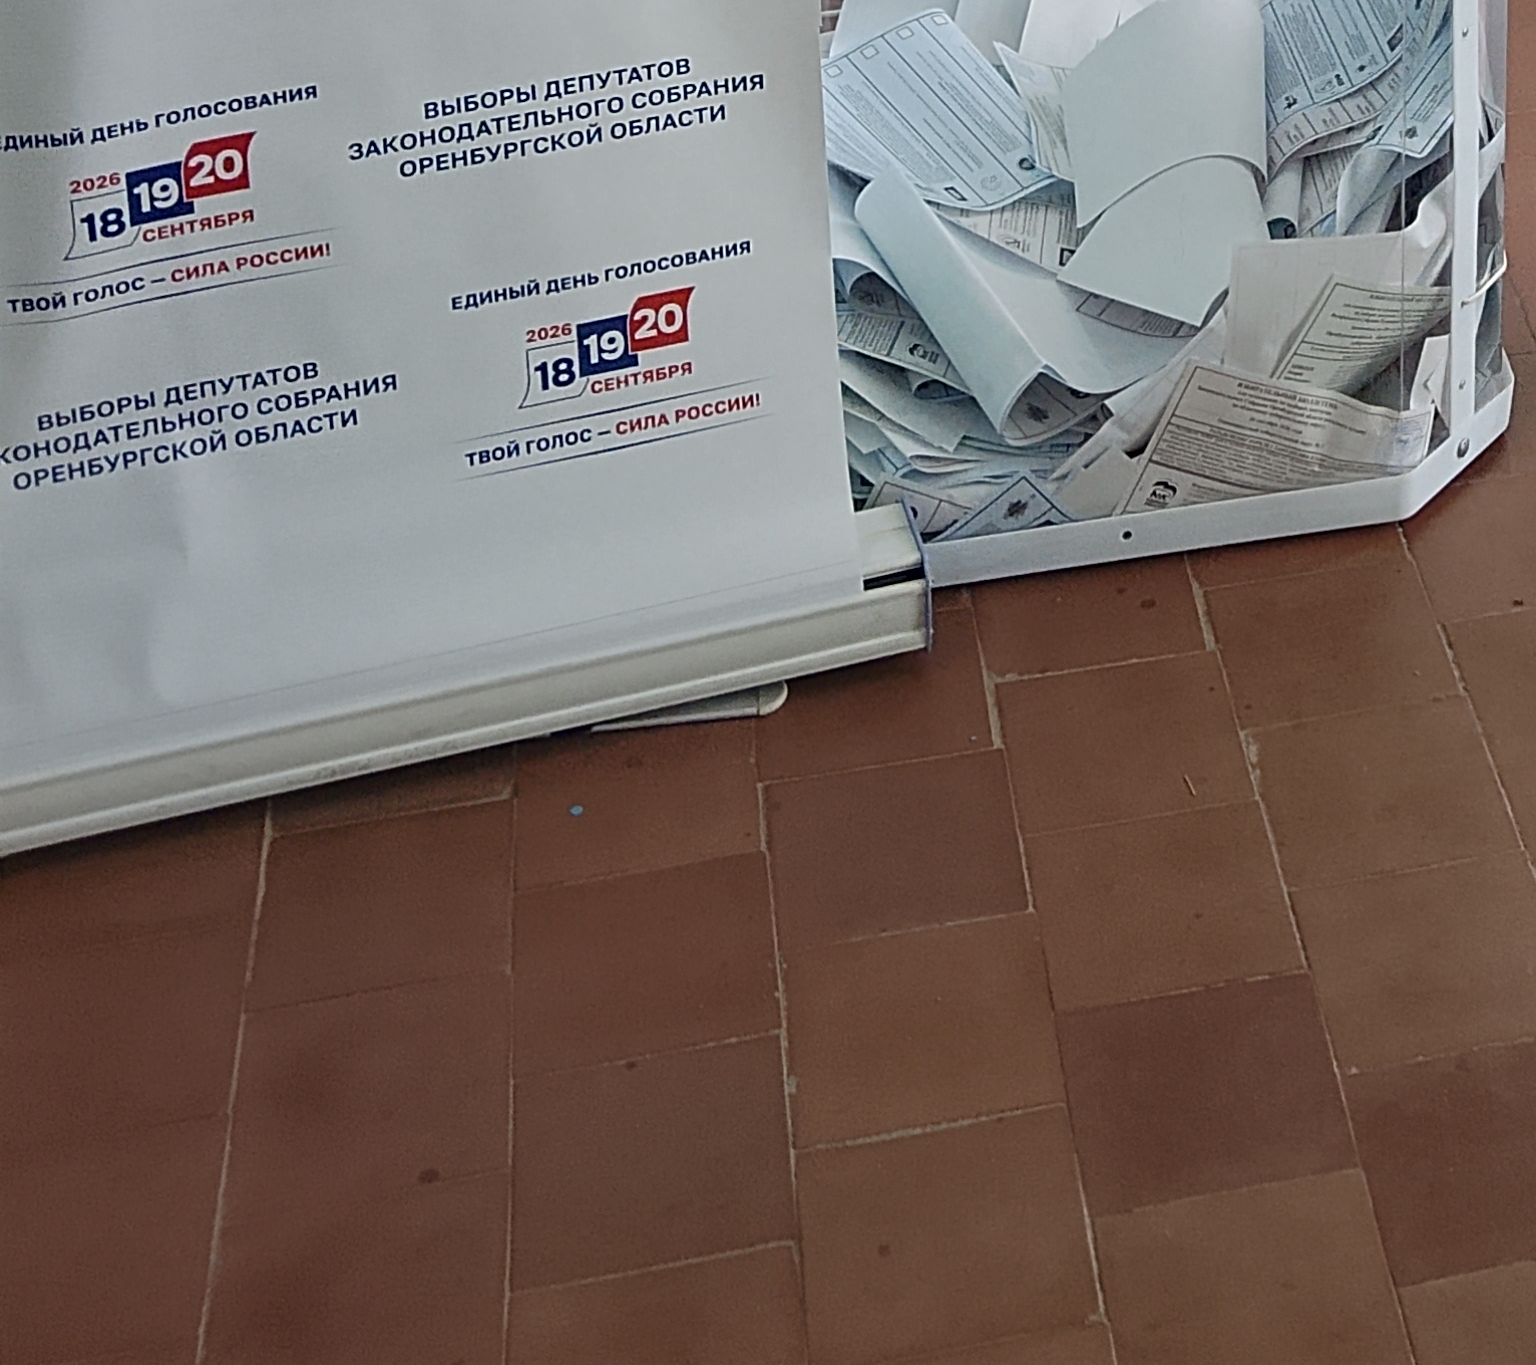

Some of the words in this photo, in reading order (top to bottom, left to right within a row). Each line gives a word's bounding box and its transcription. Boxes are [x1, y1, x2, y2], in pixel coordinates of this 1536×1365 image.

[0, 127, 86, 154] ДИНЫЙ
[90, 118, 149, 145] ДЕНЬ
[154, 85, 318, 128] ГОЛОСОВАНИЯ
[348, 90, 624, 161] ЗАКОНОДАТЕЛЬНОГО
[630, 73, 765, 112] СОБРАНИЯ
[423, 83, 537, 120] ВЫБОРЫ
[544, 58, 691, 101] ДЕПУТАТОВ
[399, 127, 604, 178] ОРЕНБУРГСКОЙ
[610, 104, 726, 140] ОБЛАСТИ
[68, 172, 121, 195] 2026
[79, 207, 127, 243] 18
[134, 177, 179, 213] 19
[188, 148, 243, 187] 20
[142, 209, 255, 243] СЕНТЯБРЯ
[6, 291, 67, 313] ТВОЙ
[72, 276, 146, 307] ГОЛОС
[171, 260, 230, 287] СИЛА
[235, 242, 331, 275] РОССИИ!
[451, 278, 540, 311] ЕДИНЫЙ
[545, 272, 600, 296] ДЕНЬ
[604, 240, 751, 282] ГОЛОСОВАНИЯ
[526, 323, 573, 344] 2026
[533, 357, 576, 392] 18
[583, 331, 625, 365] 19
[634, 303, 685, 339] 20
[37, 390, 157, 431] ВЫБОРЫ
[163, 362, 320, 408] ДЕПУТАТОВ
[255, 374, 398, 418] СОБРАНИЯ
[590, 361, 693, 394] СЕНТЯБРЯ
[12, 431, 228, 491] ОРЕНБУРГСКОЙ
[234, 410, 359, 449] ОБЛАСТИ
[464, 439, 520, 467] ТВОЙ
[525, 428, 592, 455] ГОЛОС
[615, 413, 670, 435] СИЛА
[675, 393, 761, 424] РОССИИ!
